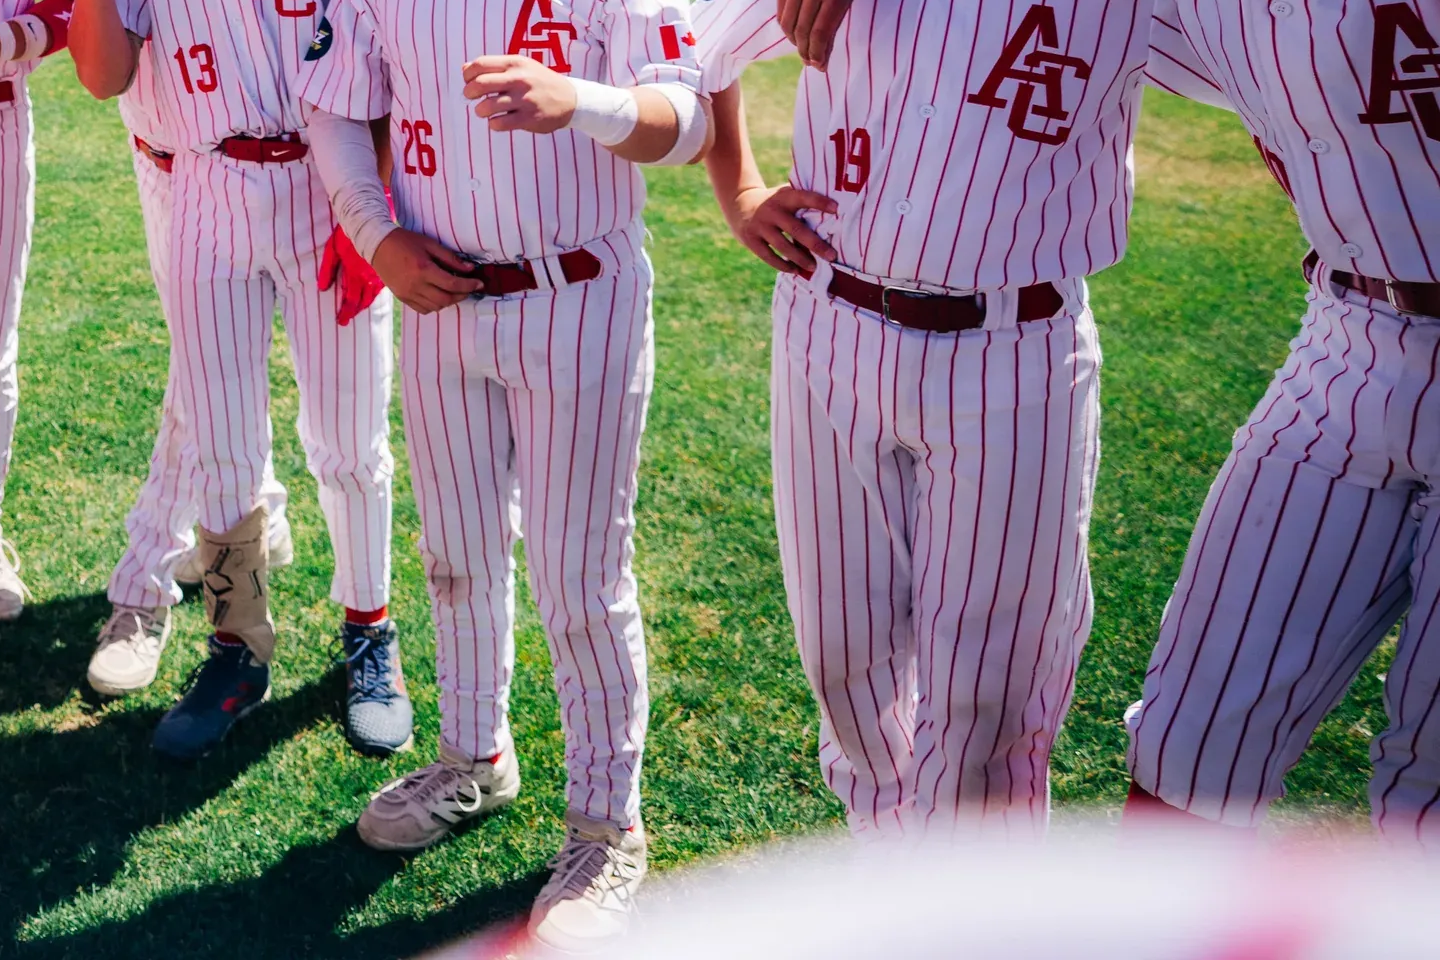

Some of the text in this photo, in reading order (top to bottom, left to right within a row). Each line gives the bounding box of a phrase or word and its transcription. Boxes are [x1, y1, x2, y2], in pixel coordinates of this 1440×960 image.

[173, 44, 219, 95] 13
[966, 3, 1092, 147] AC
[401, 120, 437, 178] 26
[829, 128, 872, 195] 19
